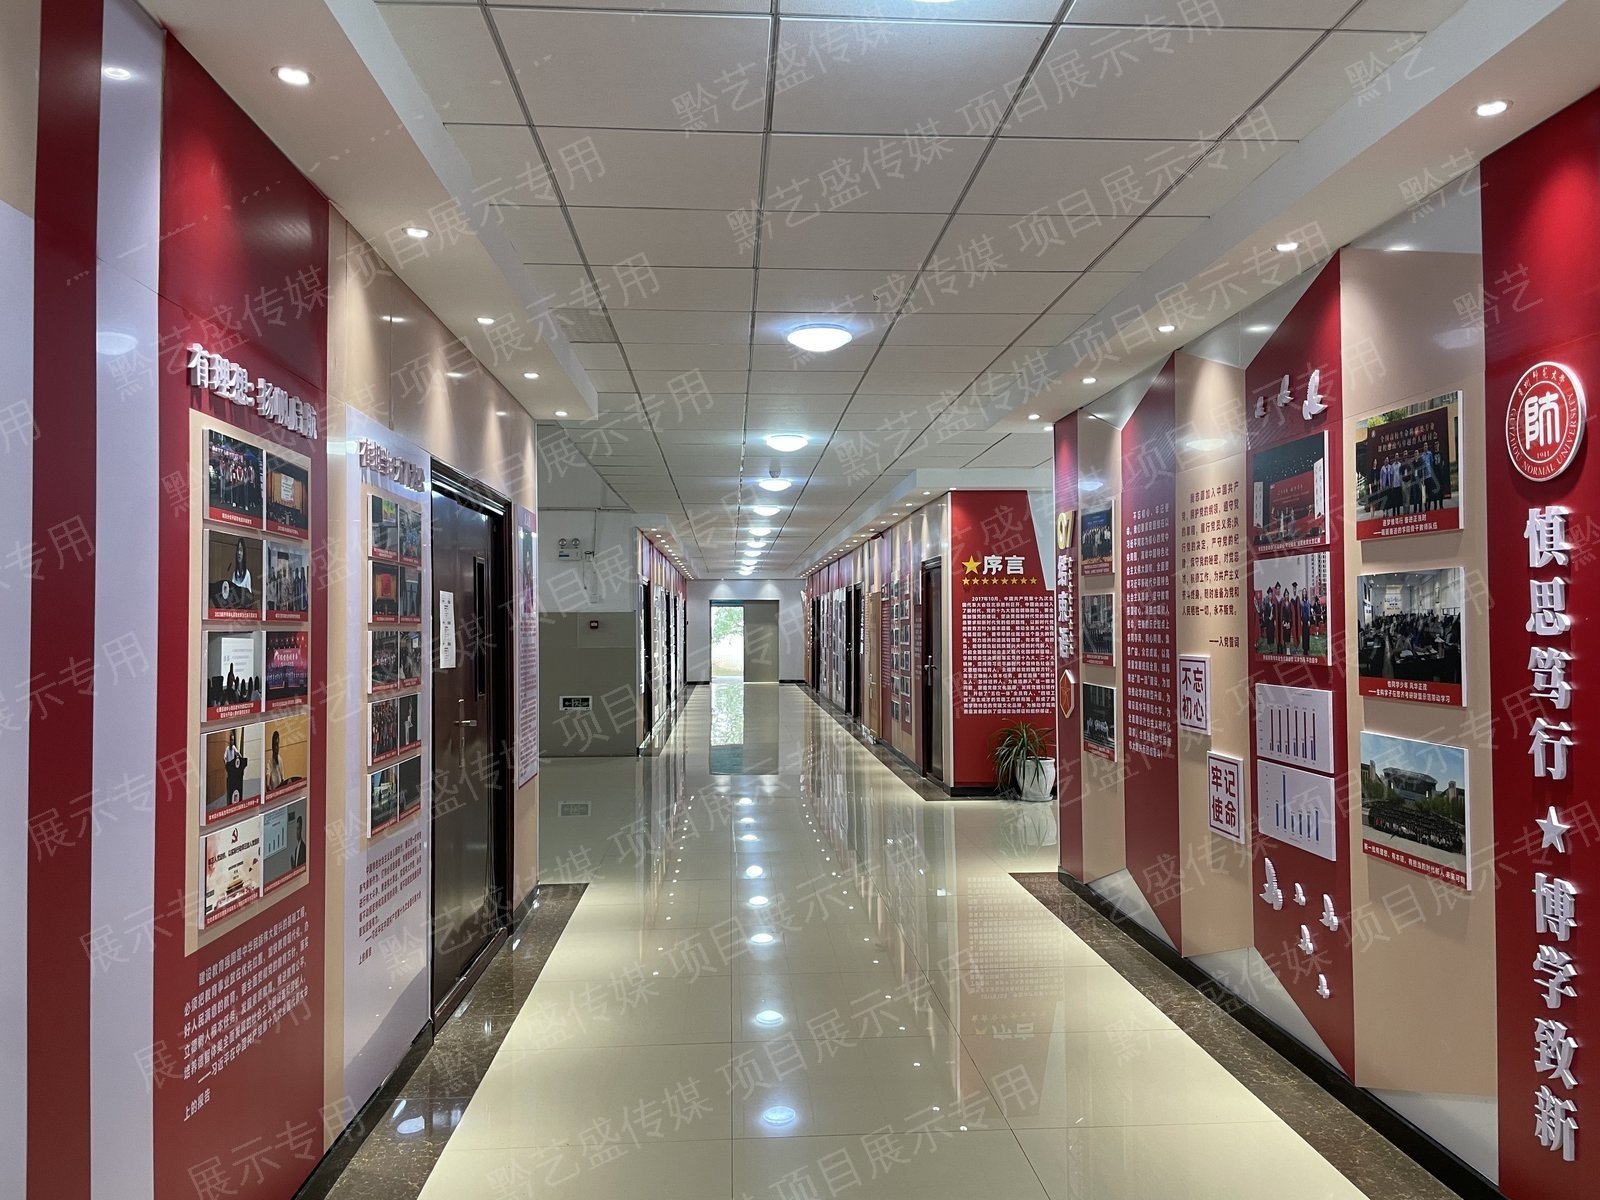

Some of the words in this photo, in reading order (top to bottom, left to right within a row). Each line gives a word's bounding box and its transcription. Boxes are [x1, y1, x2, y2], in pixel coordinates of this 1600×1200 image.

[1522, 460, 1556, 477] NORMAL
[1556, 392, 1577, 465] UNIVERSITY
[982, 555, 1025, 575] 序言
[1524, 505, 1572, 780] 慎思笃行
[1182, 667, 1204, 693] 不忘
[1182, 696, 1205, 722] 初心
[1211, 765, 1236, 798] 牢记
[1211, 795, 1236, 828] 使命
[1532, 872, 1579, 1161] 博学致新
[184, 1088, 211, 1122] 上的报告
